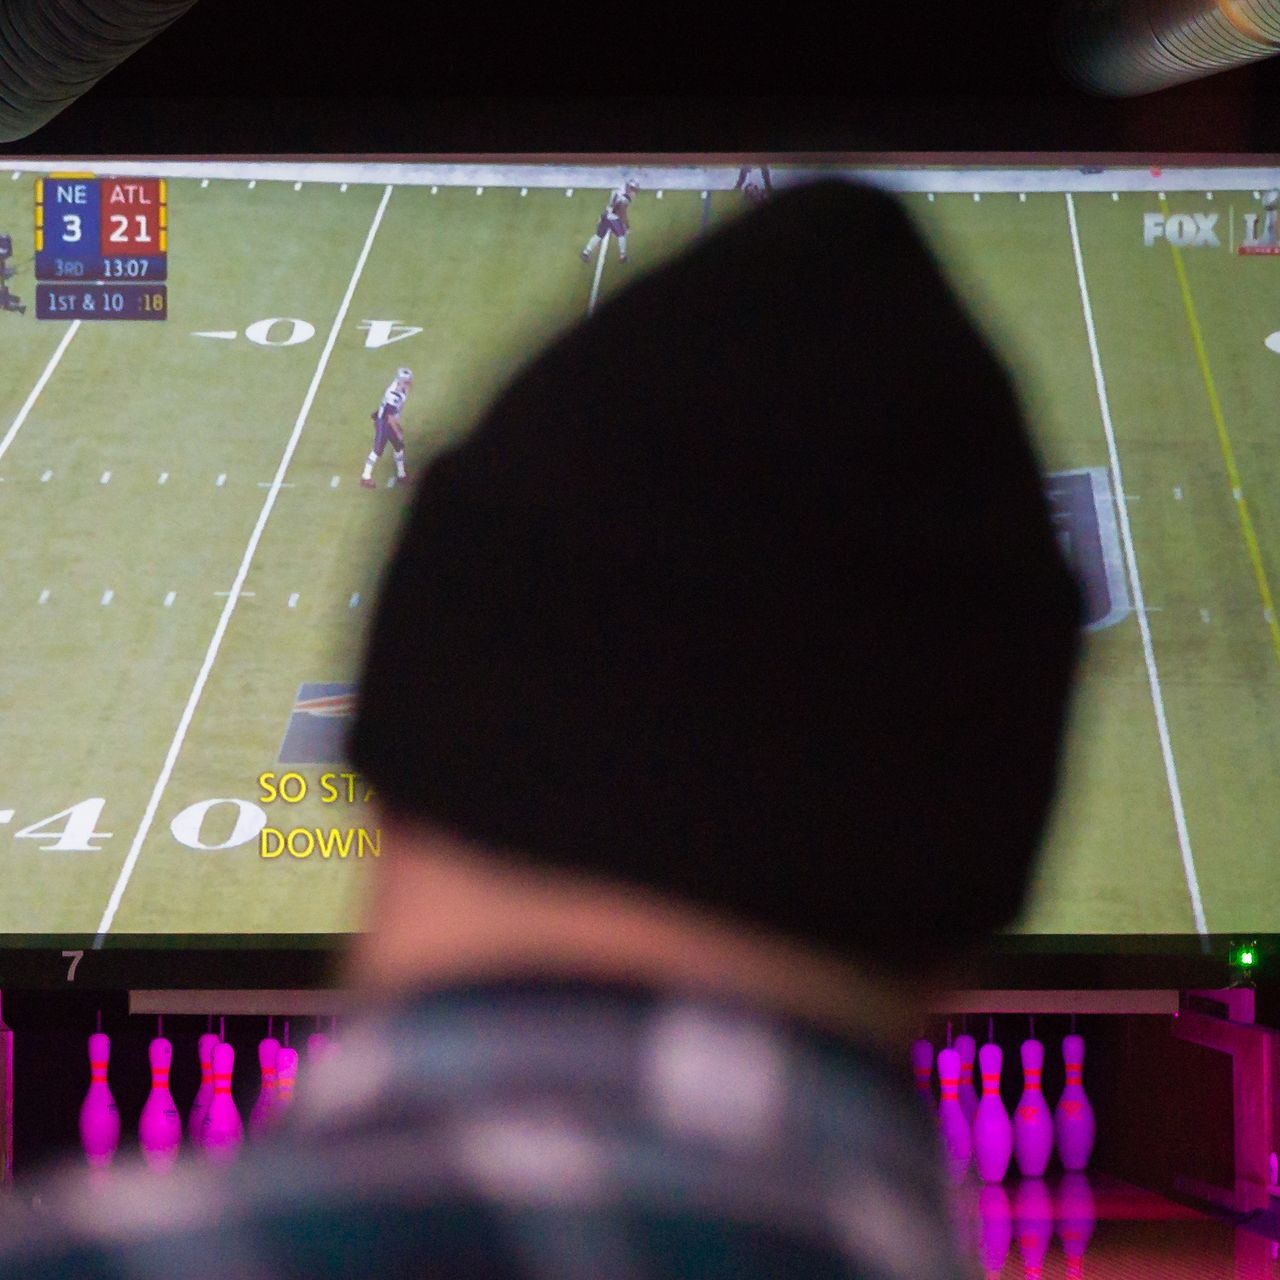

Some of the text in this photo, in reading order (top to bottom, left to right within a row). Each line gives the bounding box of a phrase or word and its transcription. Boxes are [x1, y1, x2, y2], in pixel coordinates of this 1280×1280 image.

[56, 185, 152, 204] NE ATL
[62, 214, 152, 242] 3 21
[1143, 213, 1220, 247] FOX
[54, 259, 150, 277] 3RD 13:07
[48, 293, 76, 311] 1ST
[82, 293, 95, 311] &
[102, 293, 124, 311] 10
[259, 772, 307, 803] SO
[261, 828, 381, 858] DOWN
[62, 951, 84, 981] 7
